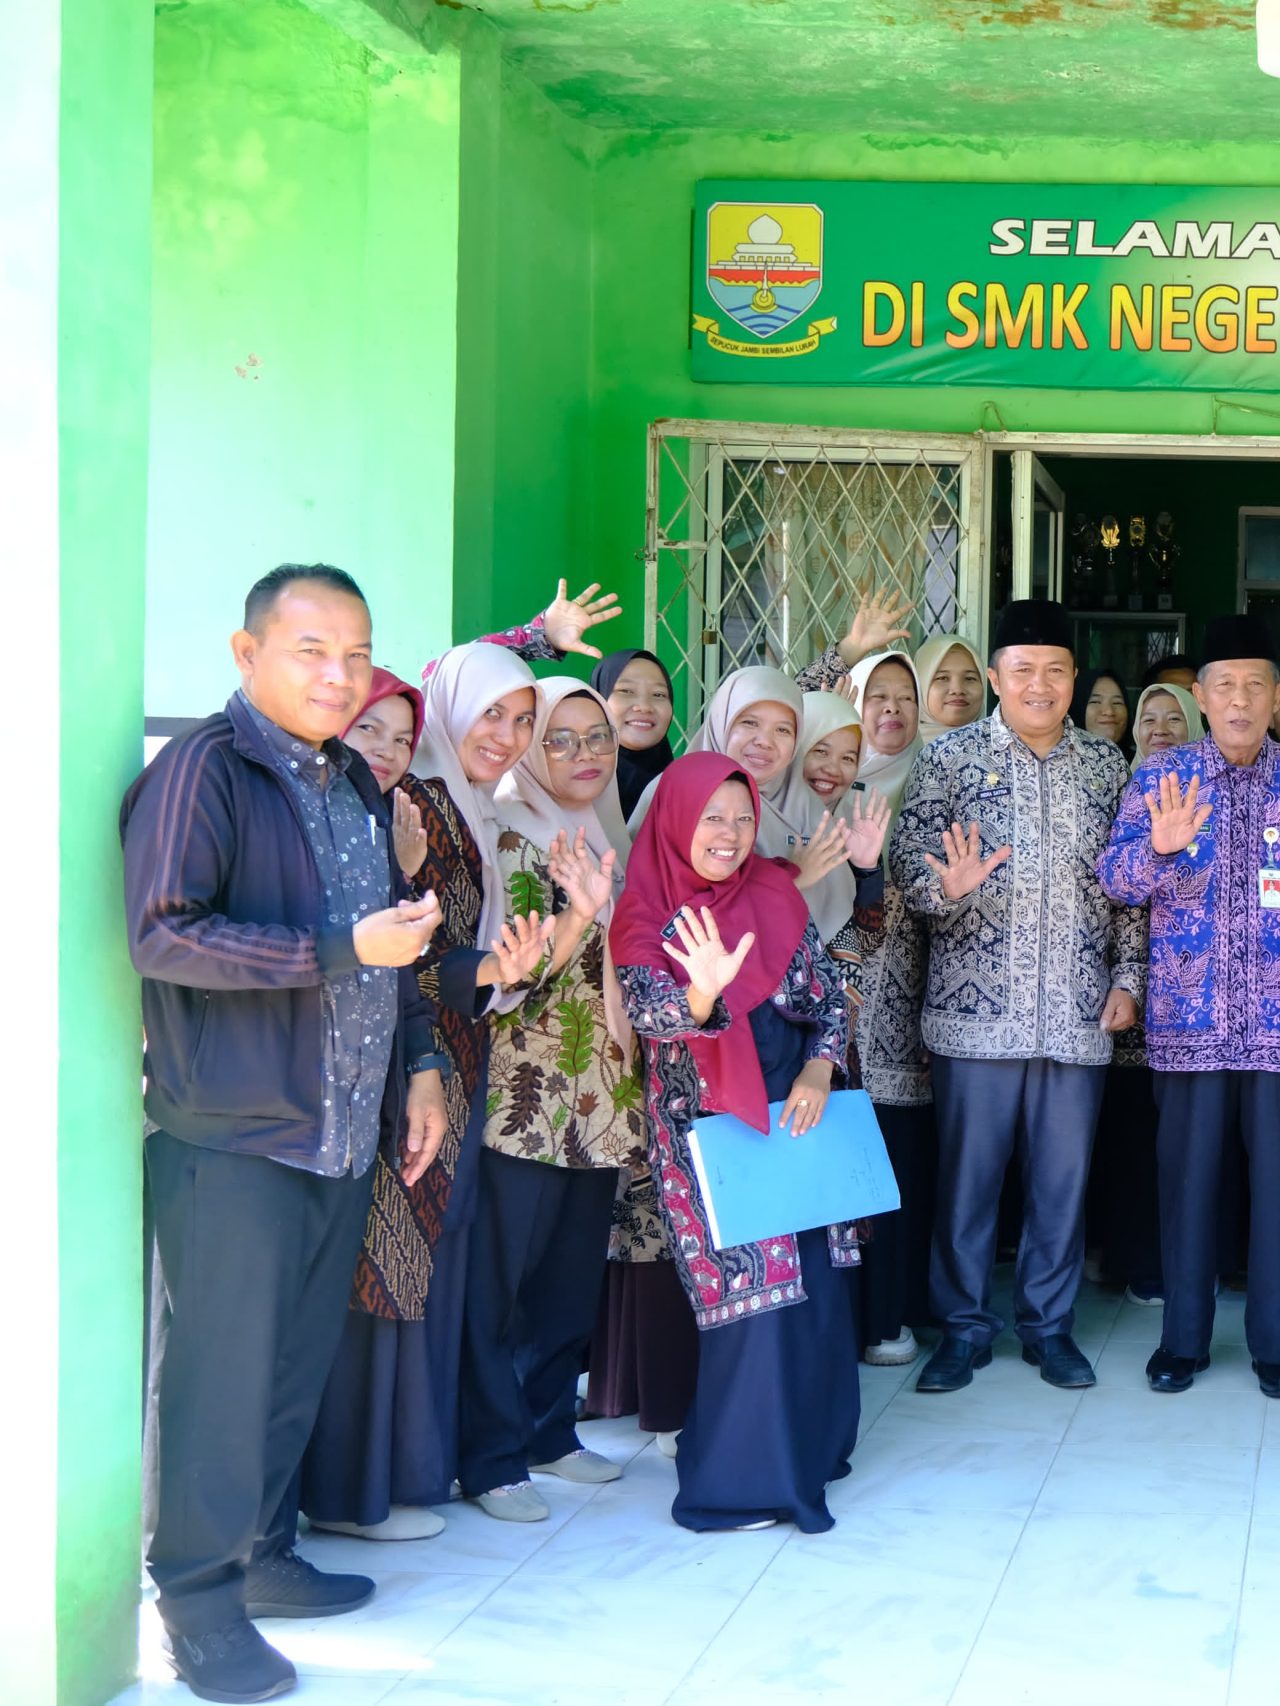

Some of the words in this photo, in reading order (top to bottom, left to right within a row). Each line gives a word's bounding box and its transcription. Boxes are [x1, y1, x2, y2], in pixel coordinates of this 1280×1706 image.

[862, 280, 925, 348] DI
[945, 280, 1090, 350] SMK
[762, 345, 794, 354] SEMBILAN
[796, 339, 816, 352] LURAH
